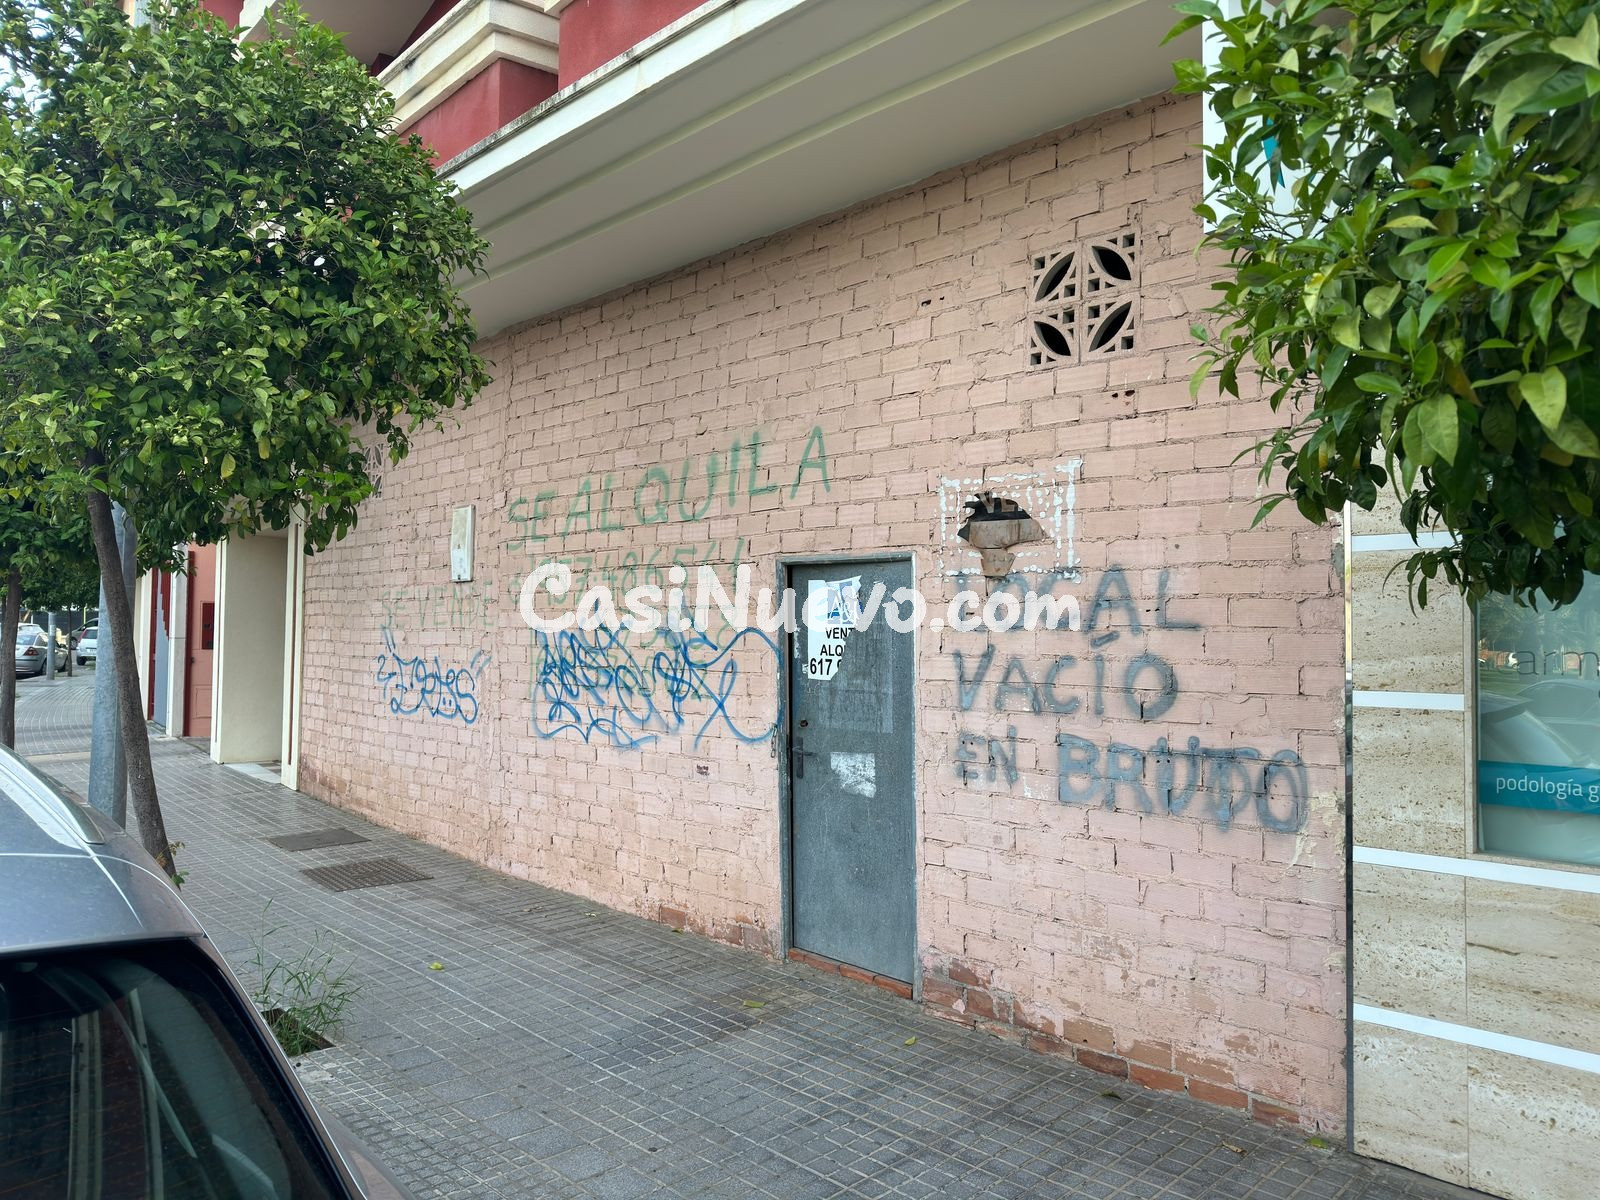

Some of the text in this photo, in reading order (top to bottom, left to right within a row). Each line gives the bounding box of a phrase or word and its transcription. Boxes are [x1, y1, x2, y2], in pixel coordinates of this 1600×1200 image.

[561, 425, 831, 538] ALQUILA
[809, 657, 833, 675] 617
[955, 724, 1020, 787] EN
[1496, 775, 1583, 800] podología
